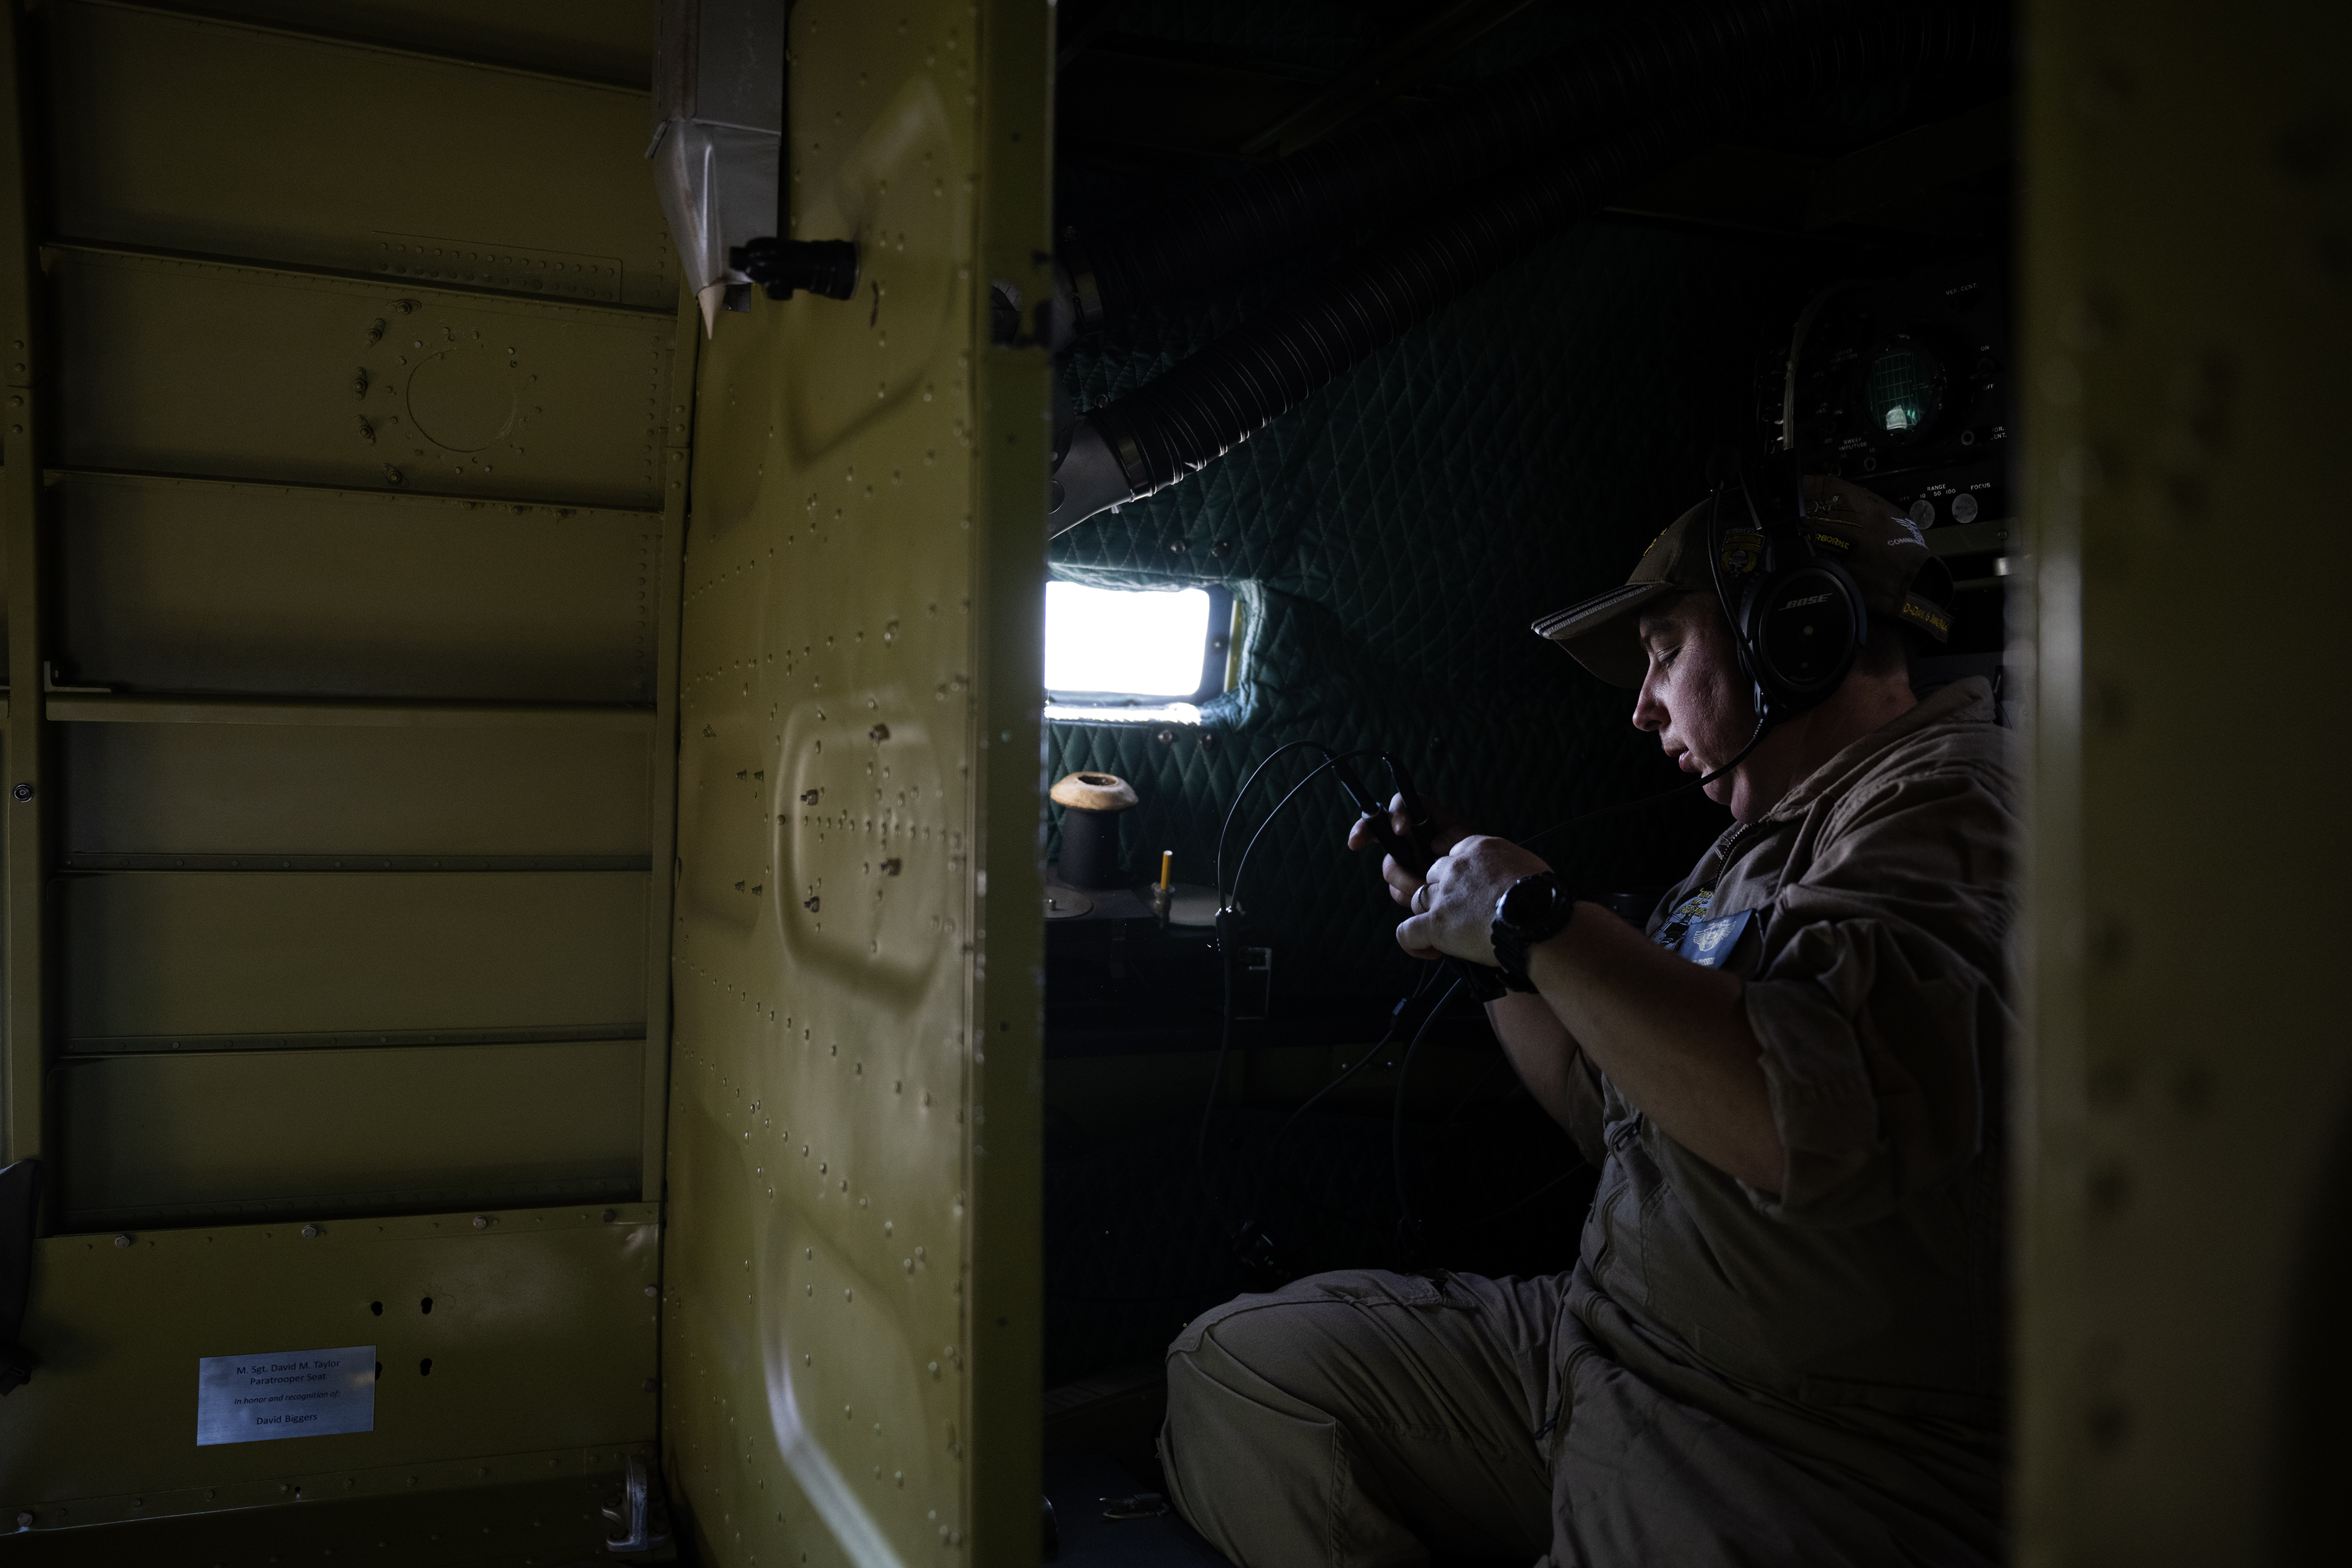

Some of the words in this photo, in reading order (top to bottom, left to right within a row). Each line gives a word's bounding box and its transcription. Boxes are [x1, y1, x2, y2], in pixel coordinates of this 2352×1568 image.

[1945, 288, 1960, 296] VER.
[1961, 282, 1978, 292] CENT.
[1835, 347, 1854, 358] SWEEP
[1831, 353, 1858, 364] DURATION
[1838, 441, 1868, 451] AMPLITUDE
[1843, 437, 1863, 446] SWEEP
[1927, 483, 1946, 492] RANGE
[1970, 482, 1991, 491] FOCUS
[1777, 592, 1833, 612] BOSE
[252, 1366, 268, 1374] Sgt.
[271, 1363, 296, 1372] David
[314, 1360, 340, 1369] Taylor
[250, 1375, 305, 1385] Paratrooper
[307, 1373, 326, 1382] Seat
[285, 1392, 328, 1401] recognition
[330, 1390, 340, 1398] of:
[256, 1416, 282, 1425] David
[285, 1414, 318, 1424] Biggers
